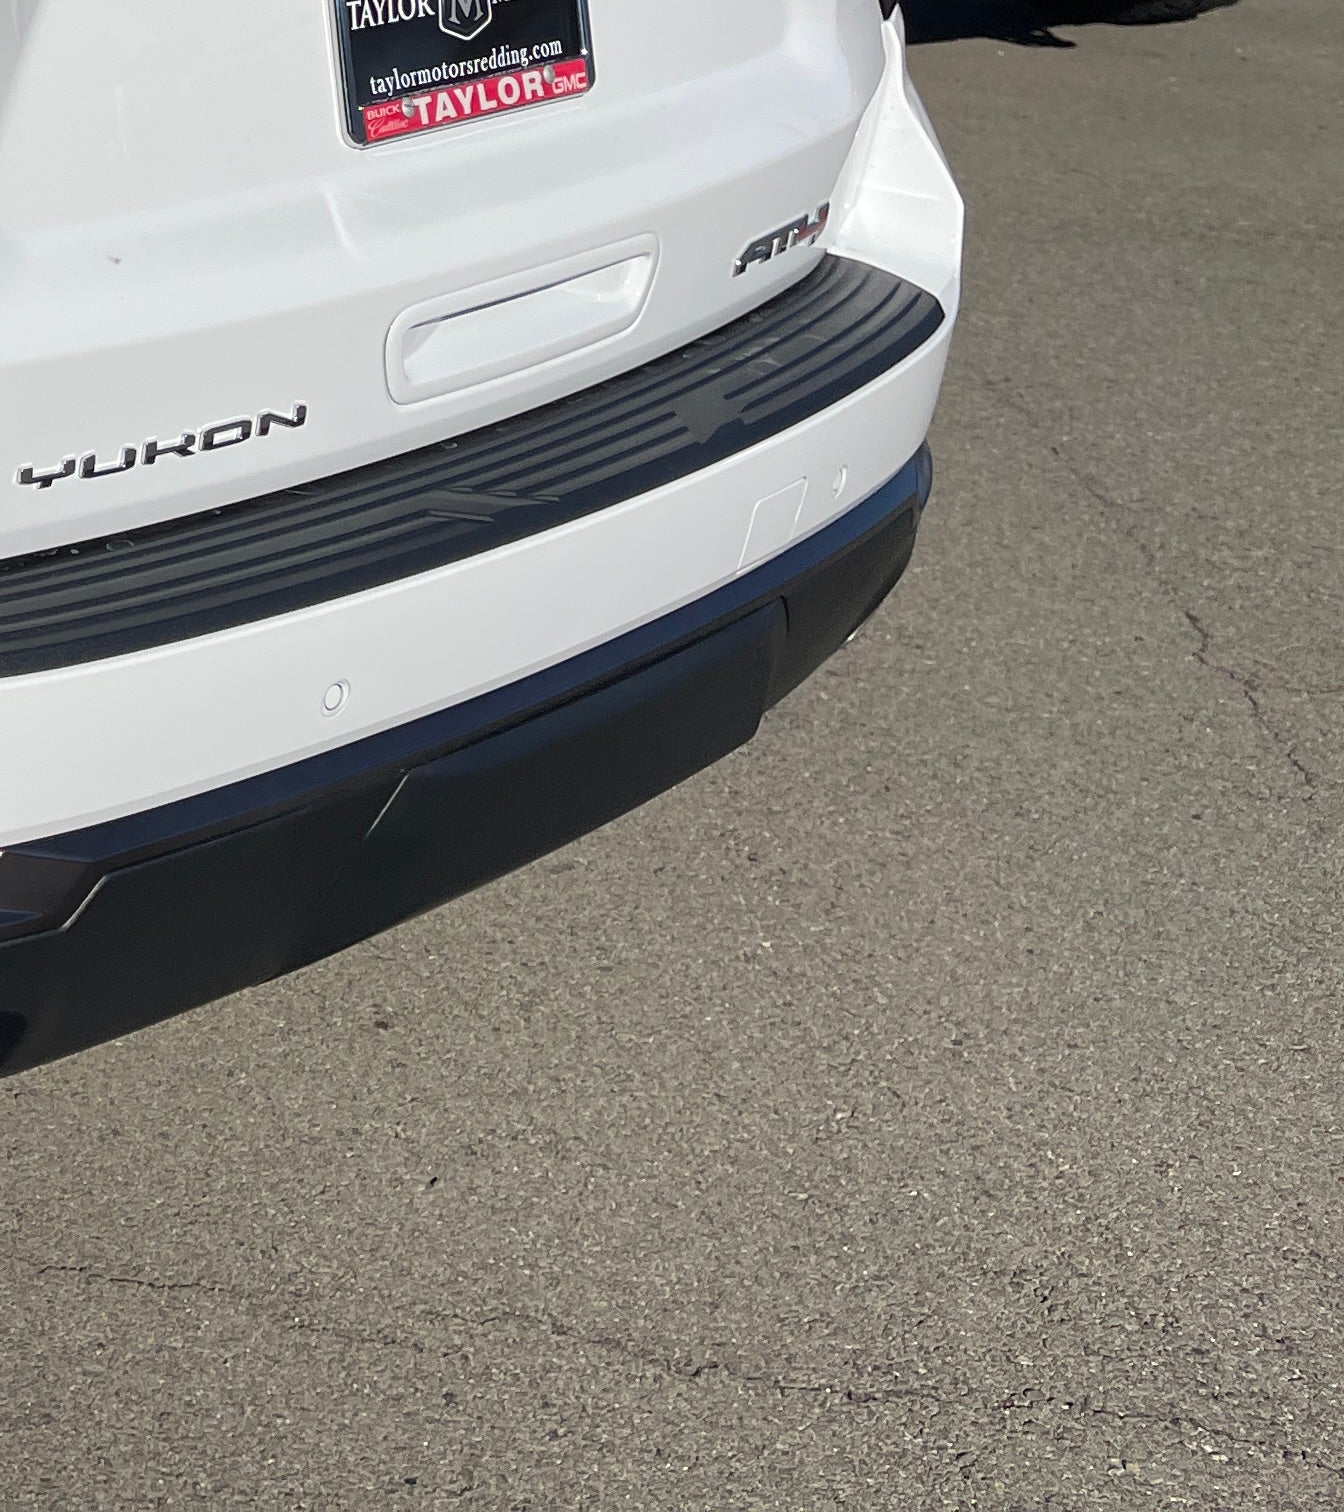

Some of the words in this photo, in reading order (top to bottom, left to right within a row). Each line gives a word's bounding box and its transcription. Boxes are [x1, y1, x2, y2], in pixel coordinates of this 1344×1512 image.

[370, 39, 563, 96] taylormotorsredding.com
[366, 103, 401, 120] BUICK
[413, 74, 545, 125] TAYLOR
[552, 72, 587, 93] GMC
[16, 403, 307, 489] YUKON
